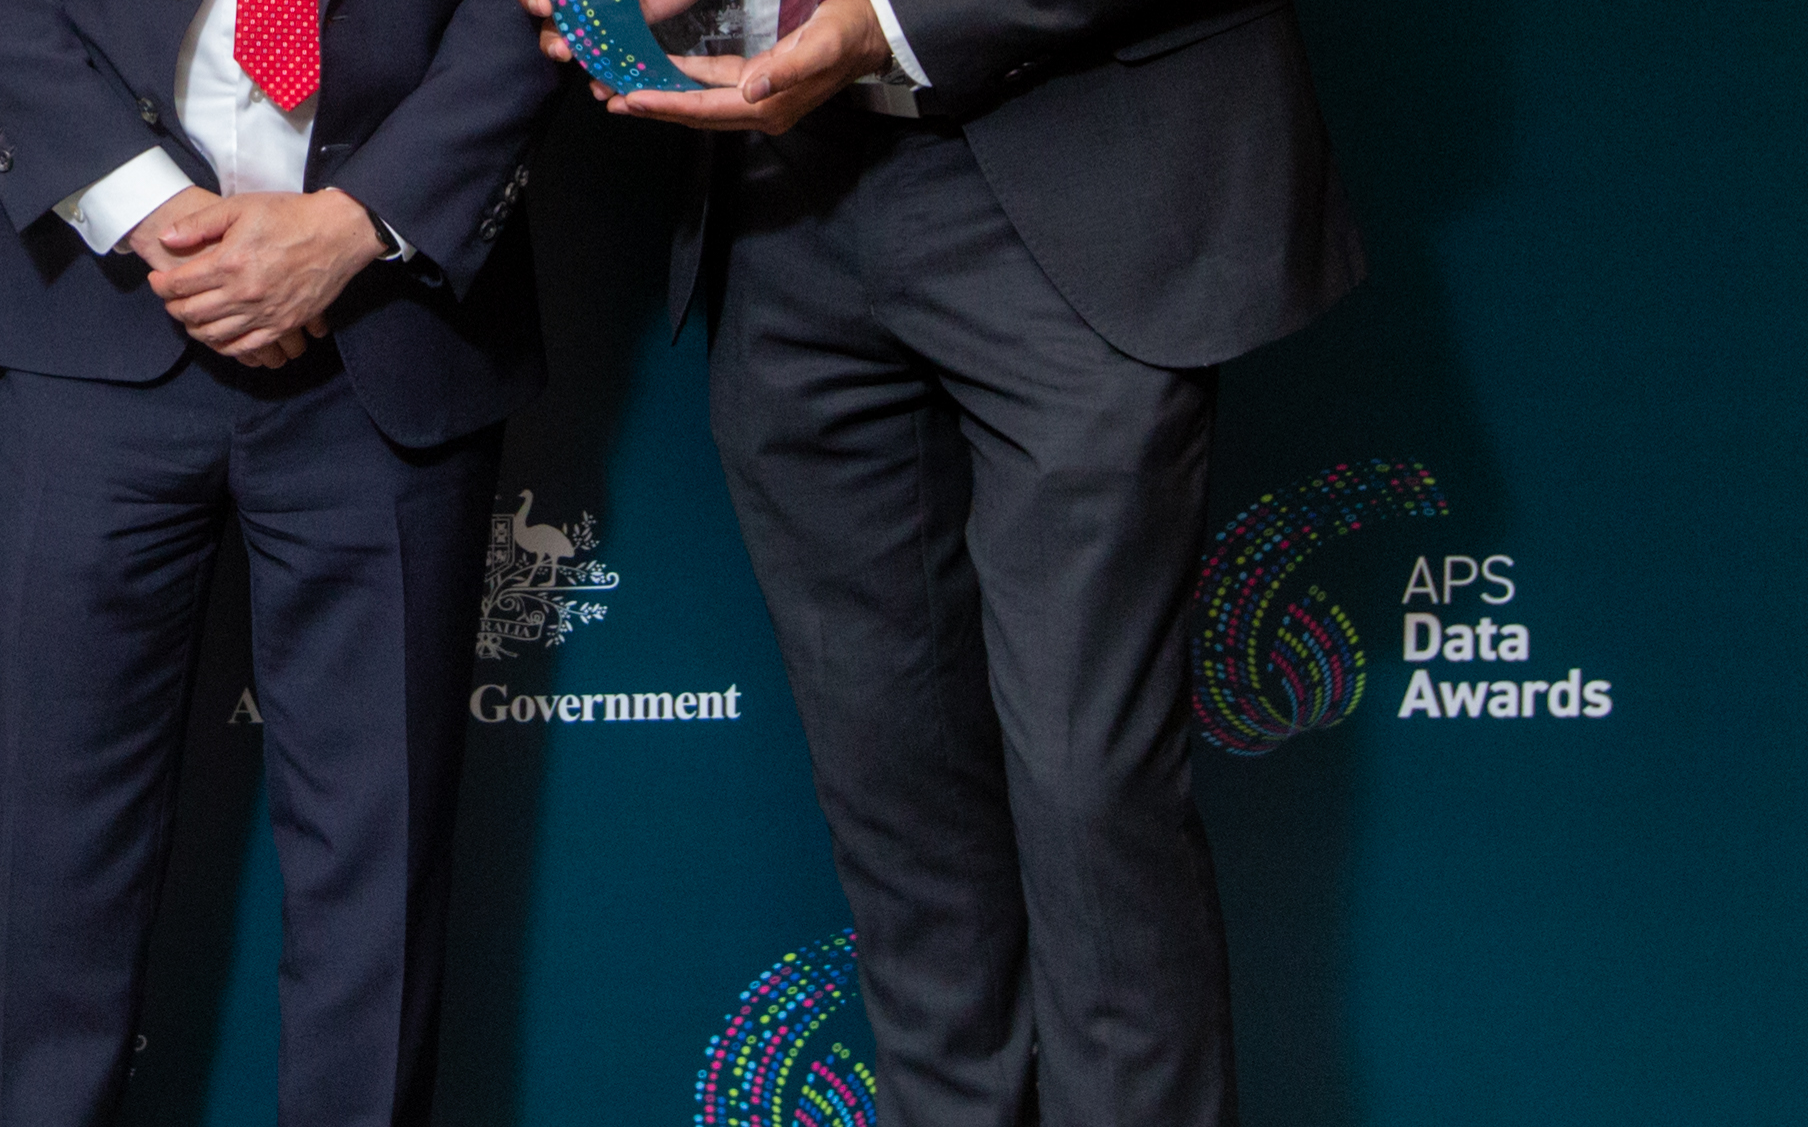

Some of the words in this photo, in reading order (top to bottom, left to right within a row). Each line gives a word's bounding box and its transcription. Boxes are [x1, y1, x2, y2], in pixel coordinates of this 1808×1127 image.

[1402, 554, 1515, 605] APS
[480, 621, 531, 638] RALIA
[1403, 612, 1529, 662] Data
[469, 683, 742, 723] Government
[1397, 668, 1613, 718] Awards
